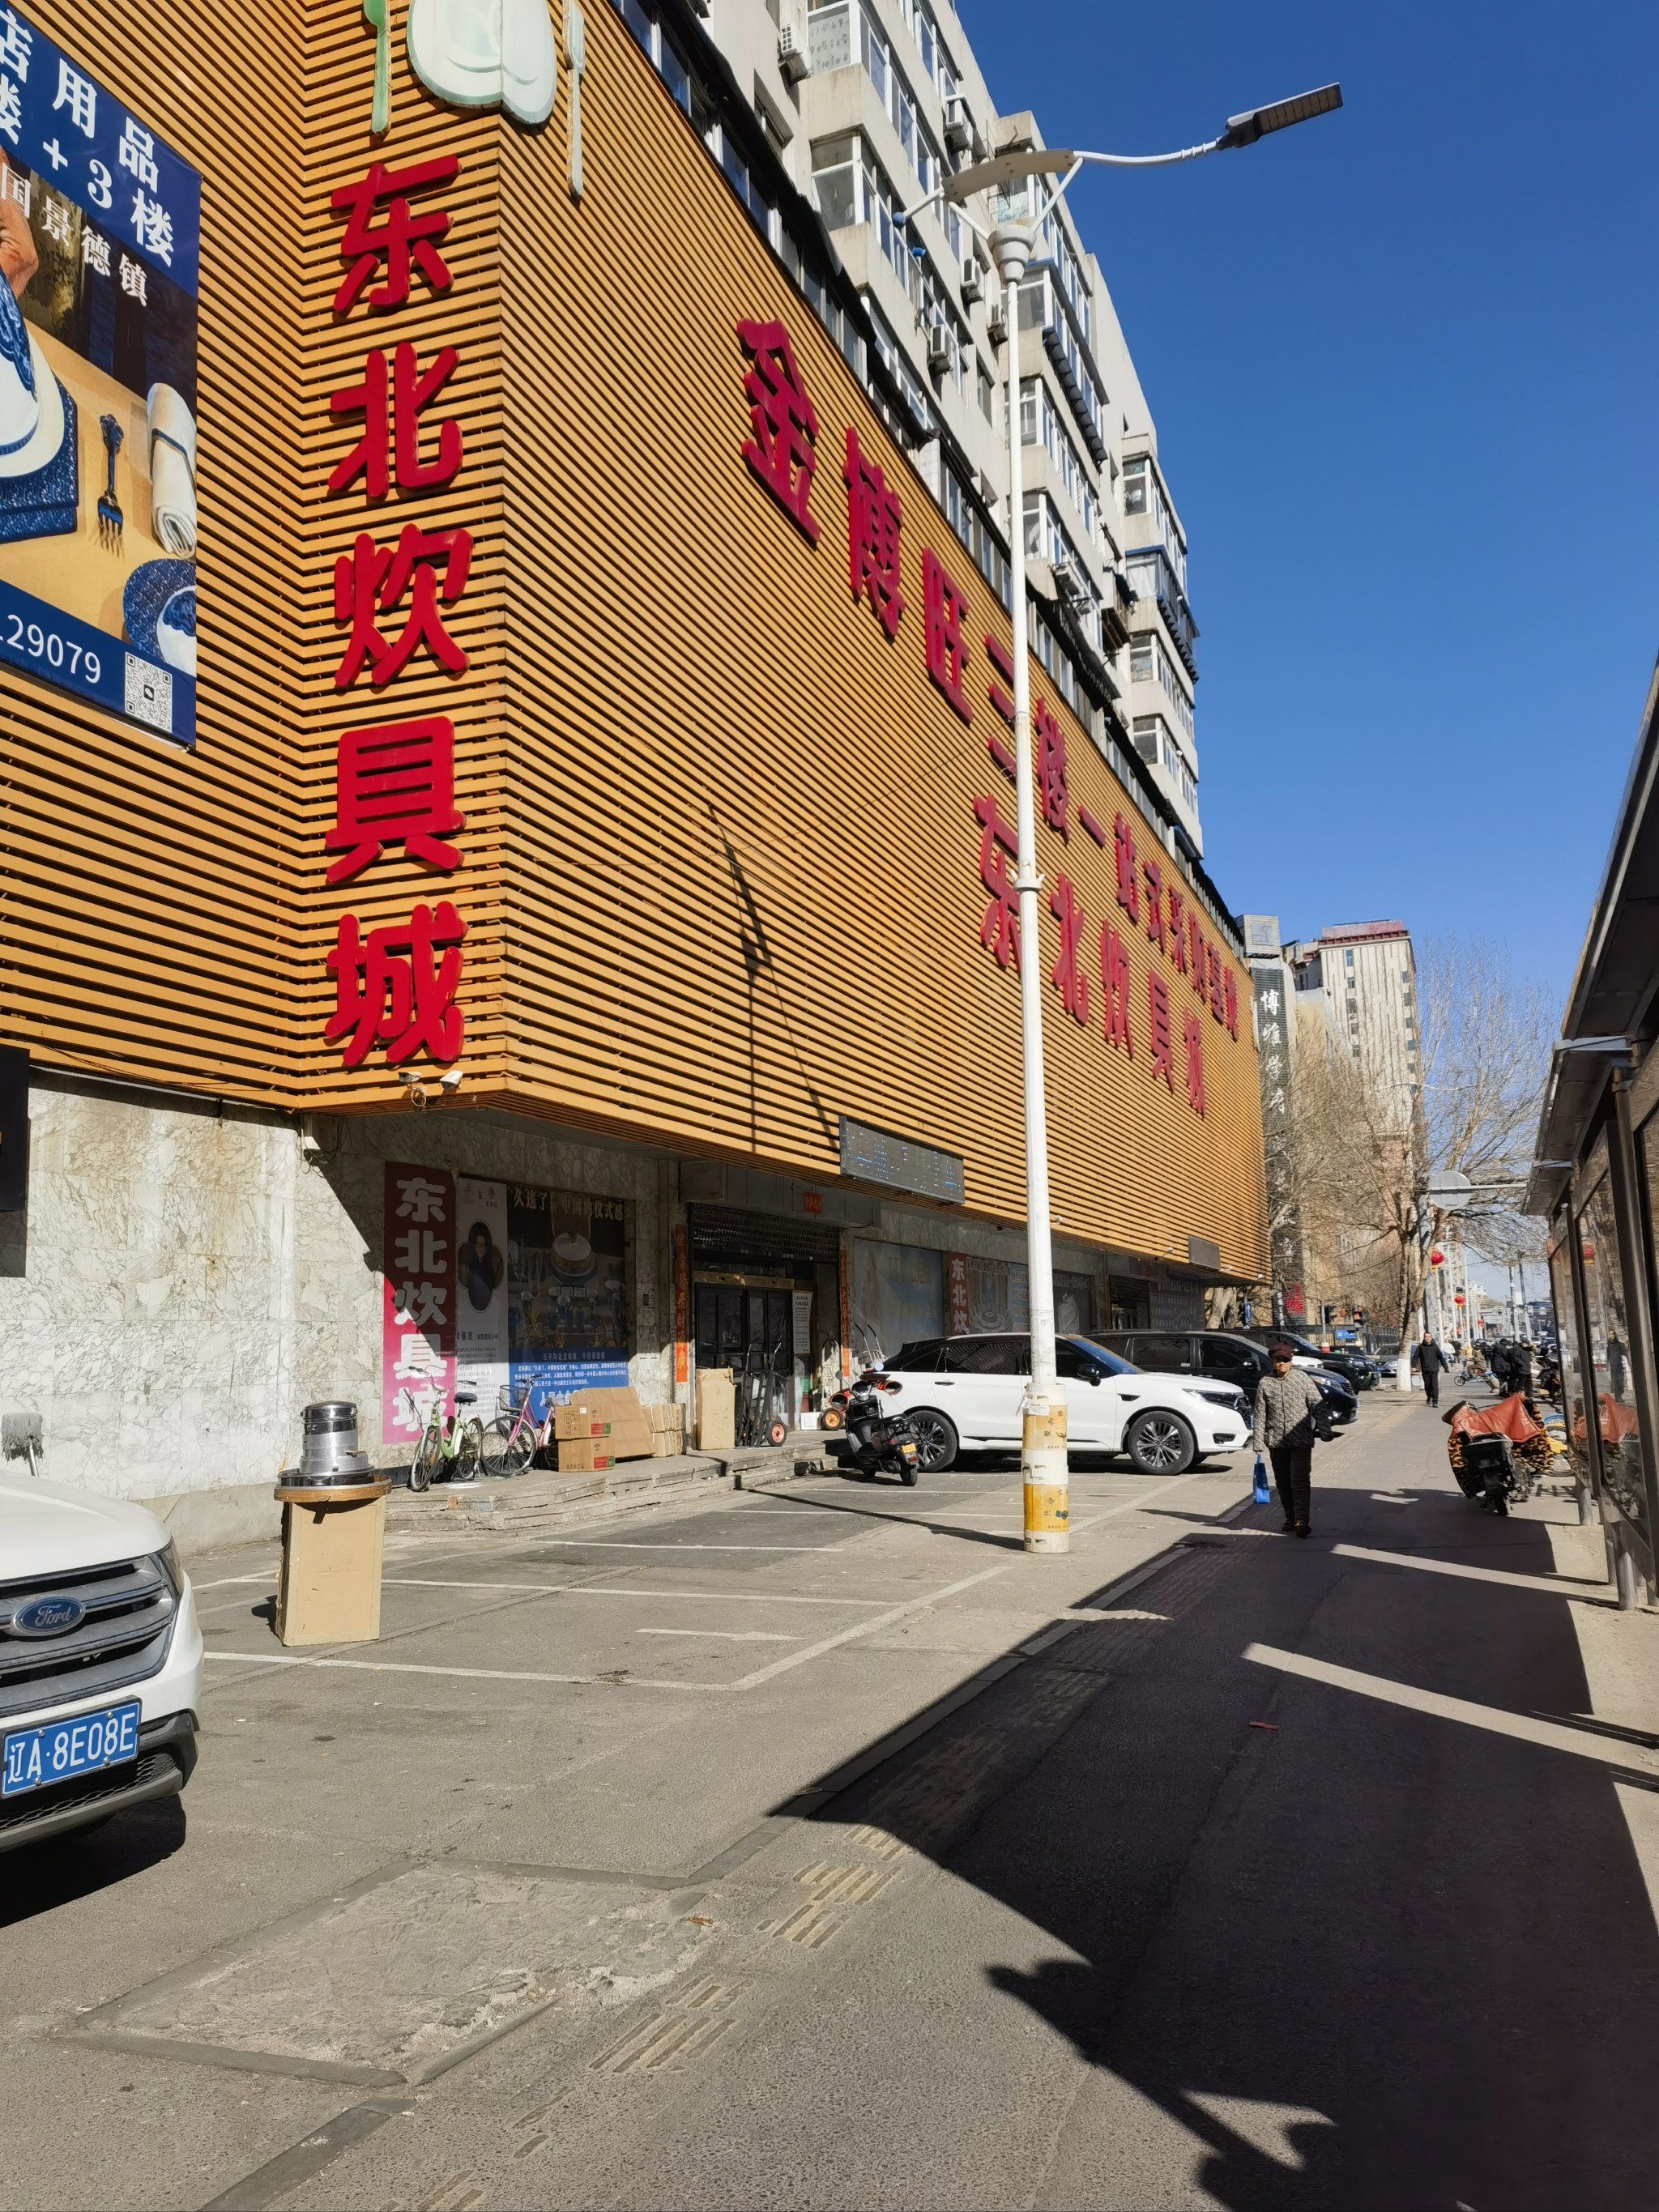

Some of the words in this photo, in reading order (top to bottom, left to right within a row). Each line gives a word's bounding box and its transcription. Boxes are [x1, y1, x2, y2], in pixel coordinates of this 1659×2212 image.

[0, 614, 101, 684] 29079
[324, 154, 474, 1068] 东北炊具城
[390, 1177, 448, 1432] 东北炊具城
[34, 1604, 73, 1628] Ford
